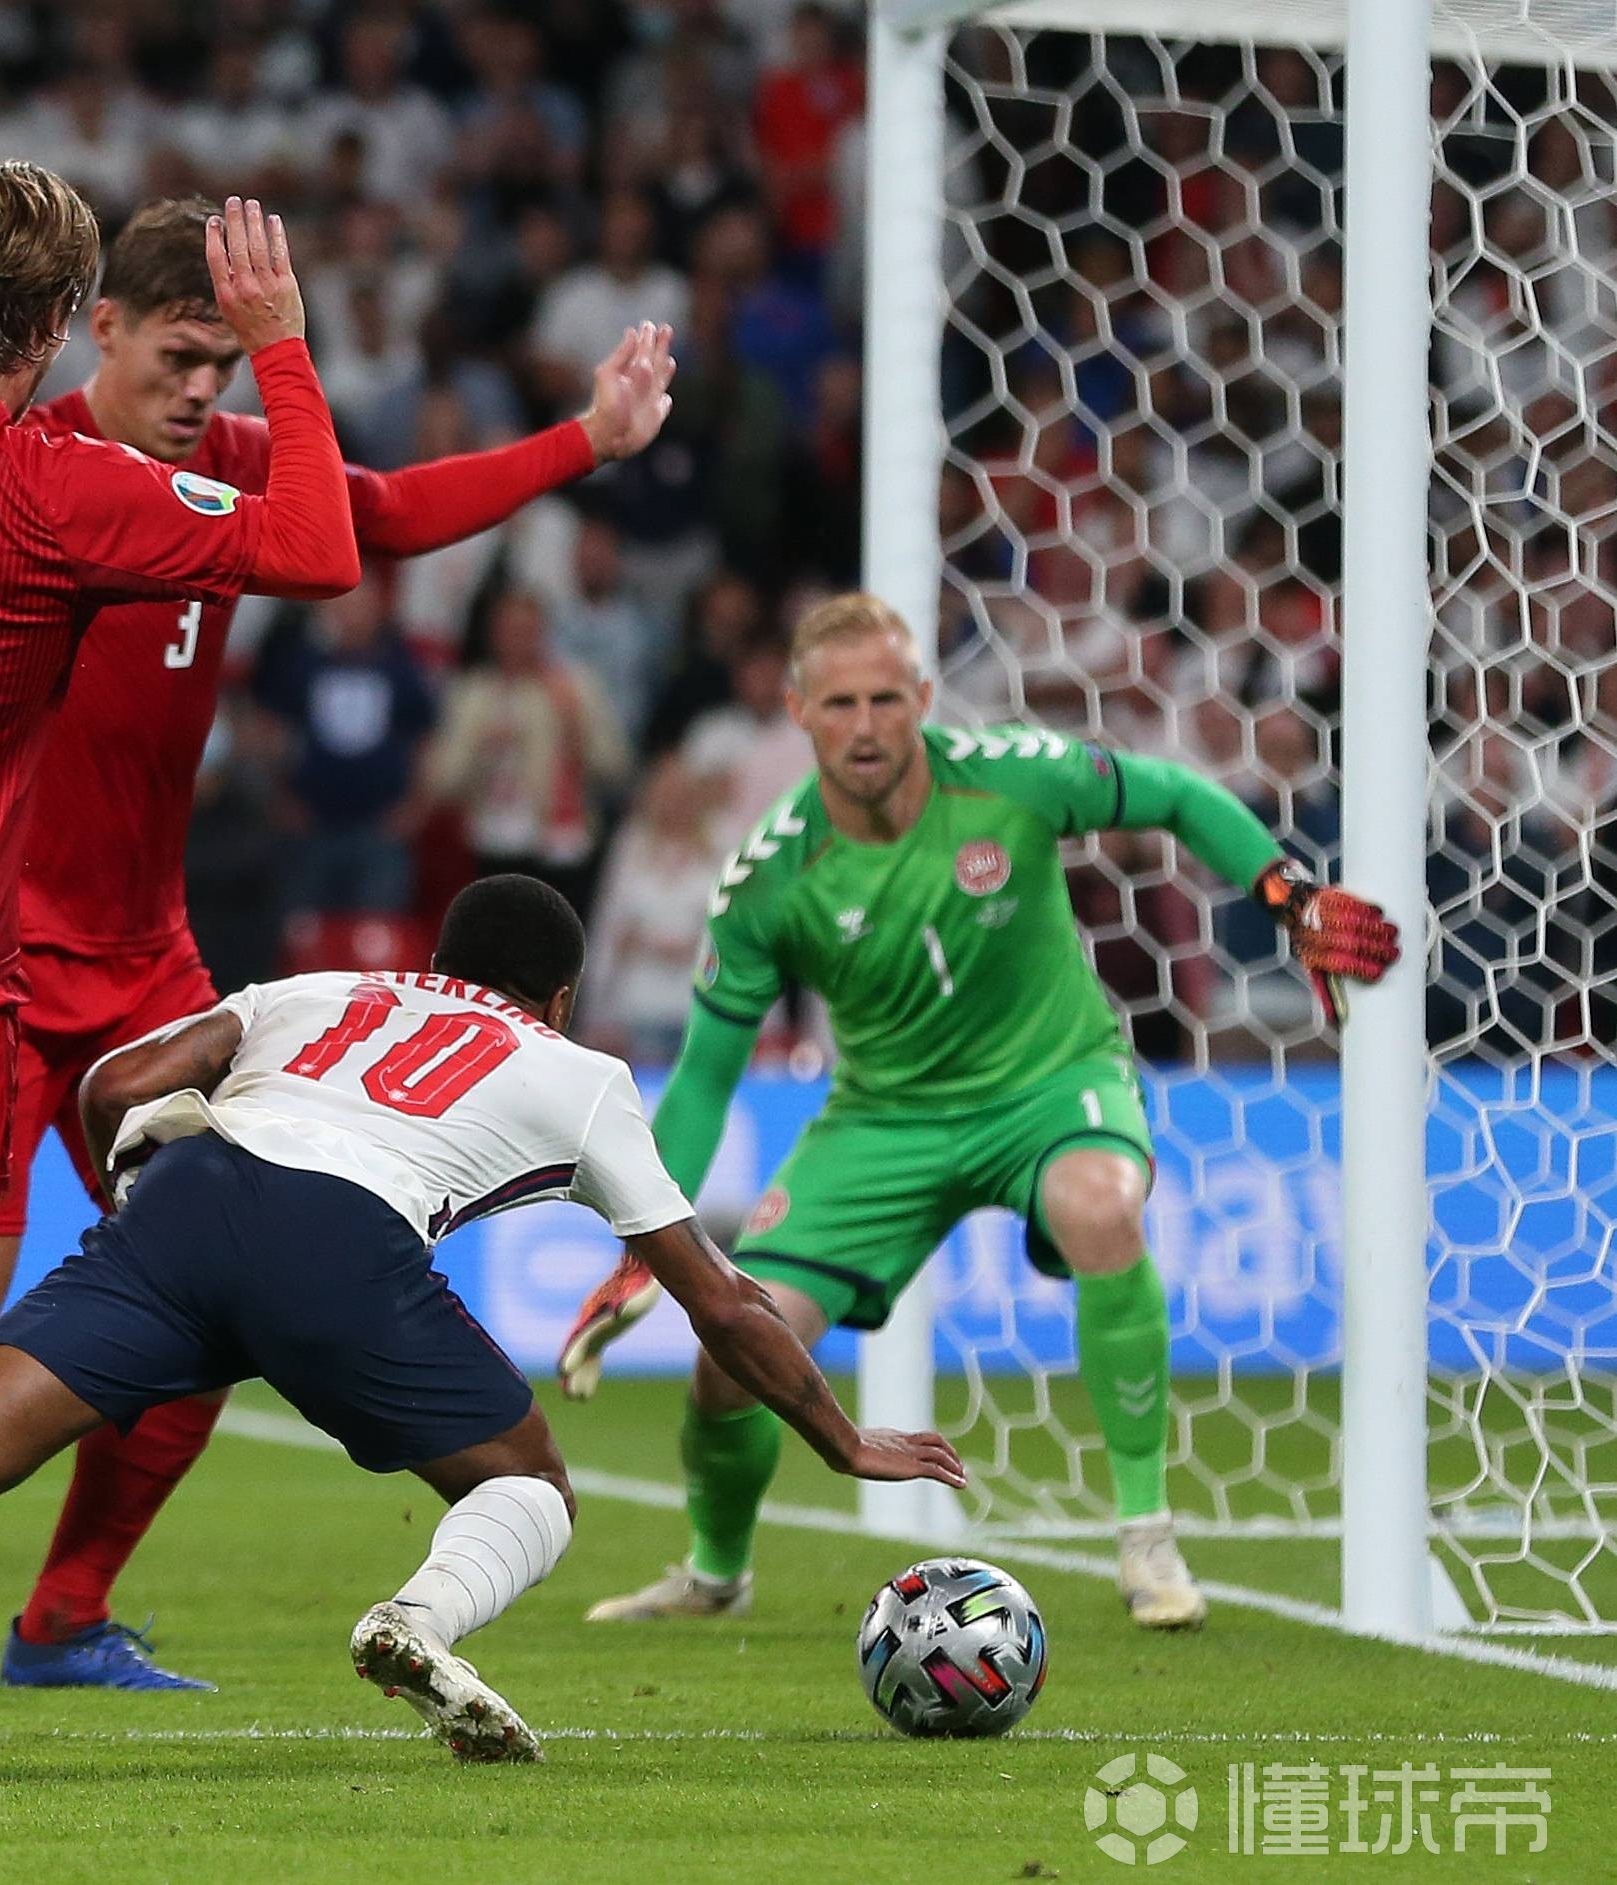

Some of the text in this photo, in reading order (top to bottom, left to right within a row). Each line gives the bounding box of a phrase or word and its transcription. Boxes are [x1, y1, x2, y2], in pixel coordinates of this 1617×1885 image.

[164, 601, 202, 669] 3
[924, 926, 954, 997] 1
[282, 982, 522, 1119] 10
[1081, 1088, 1104, 1128] 1
